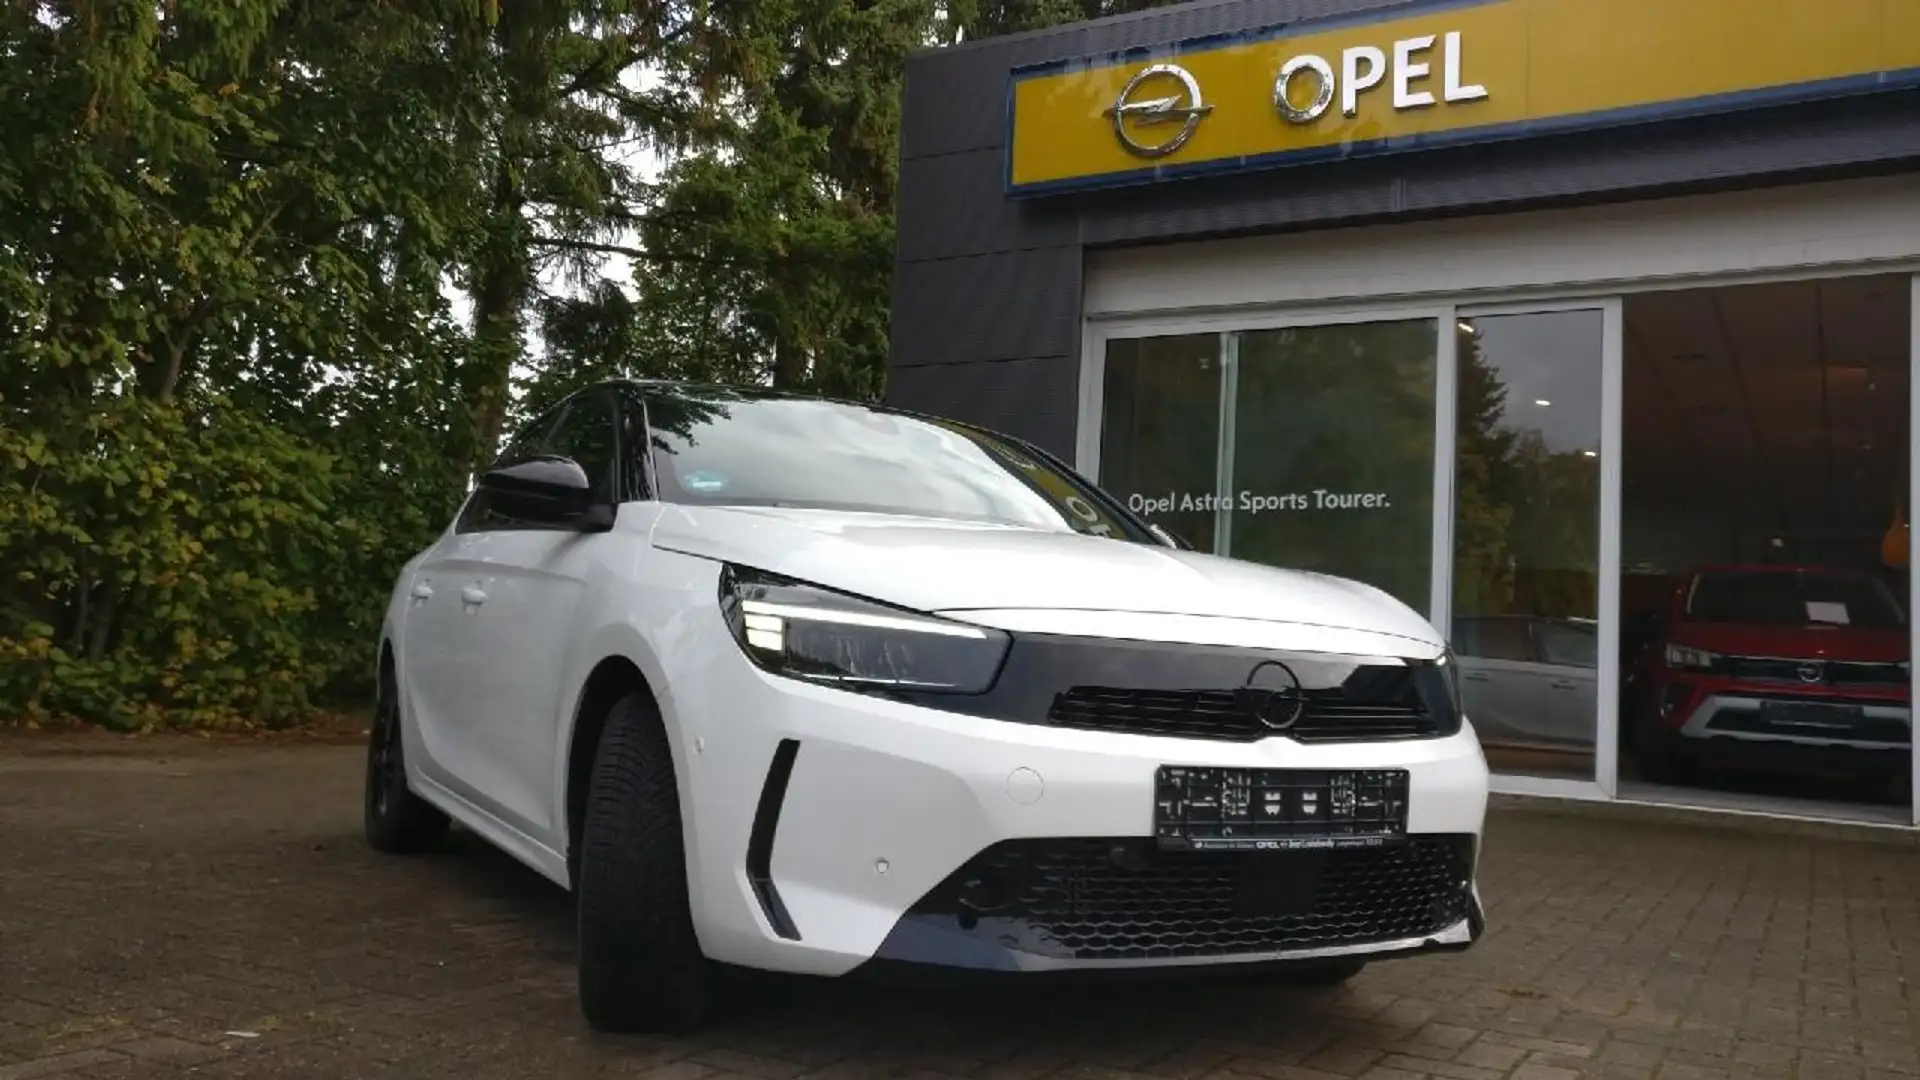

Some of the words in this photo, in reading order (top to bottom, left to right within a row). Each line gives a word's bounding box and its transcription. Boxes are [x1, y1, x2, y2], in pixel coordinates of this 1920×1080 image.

[1273, 31, 1489, 124] OPEL
[1128, 492, 1175, 516] Opel
[1180, 492, 1233, 512] Astra
[1239, 490, 1308, 515] Sports
[1312, 488, 1391, 510] Tourer.
